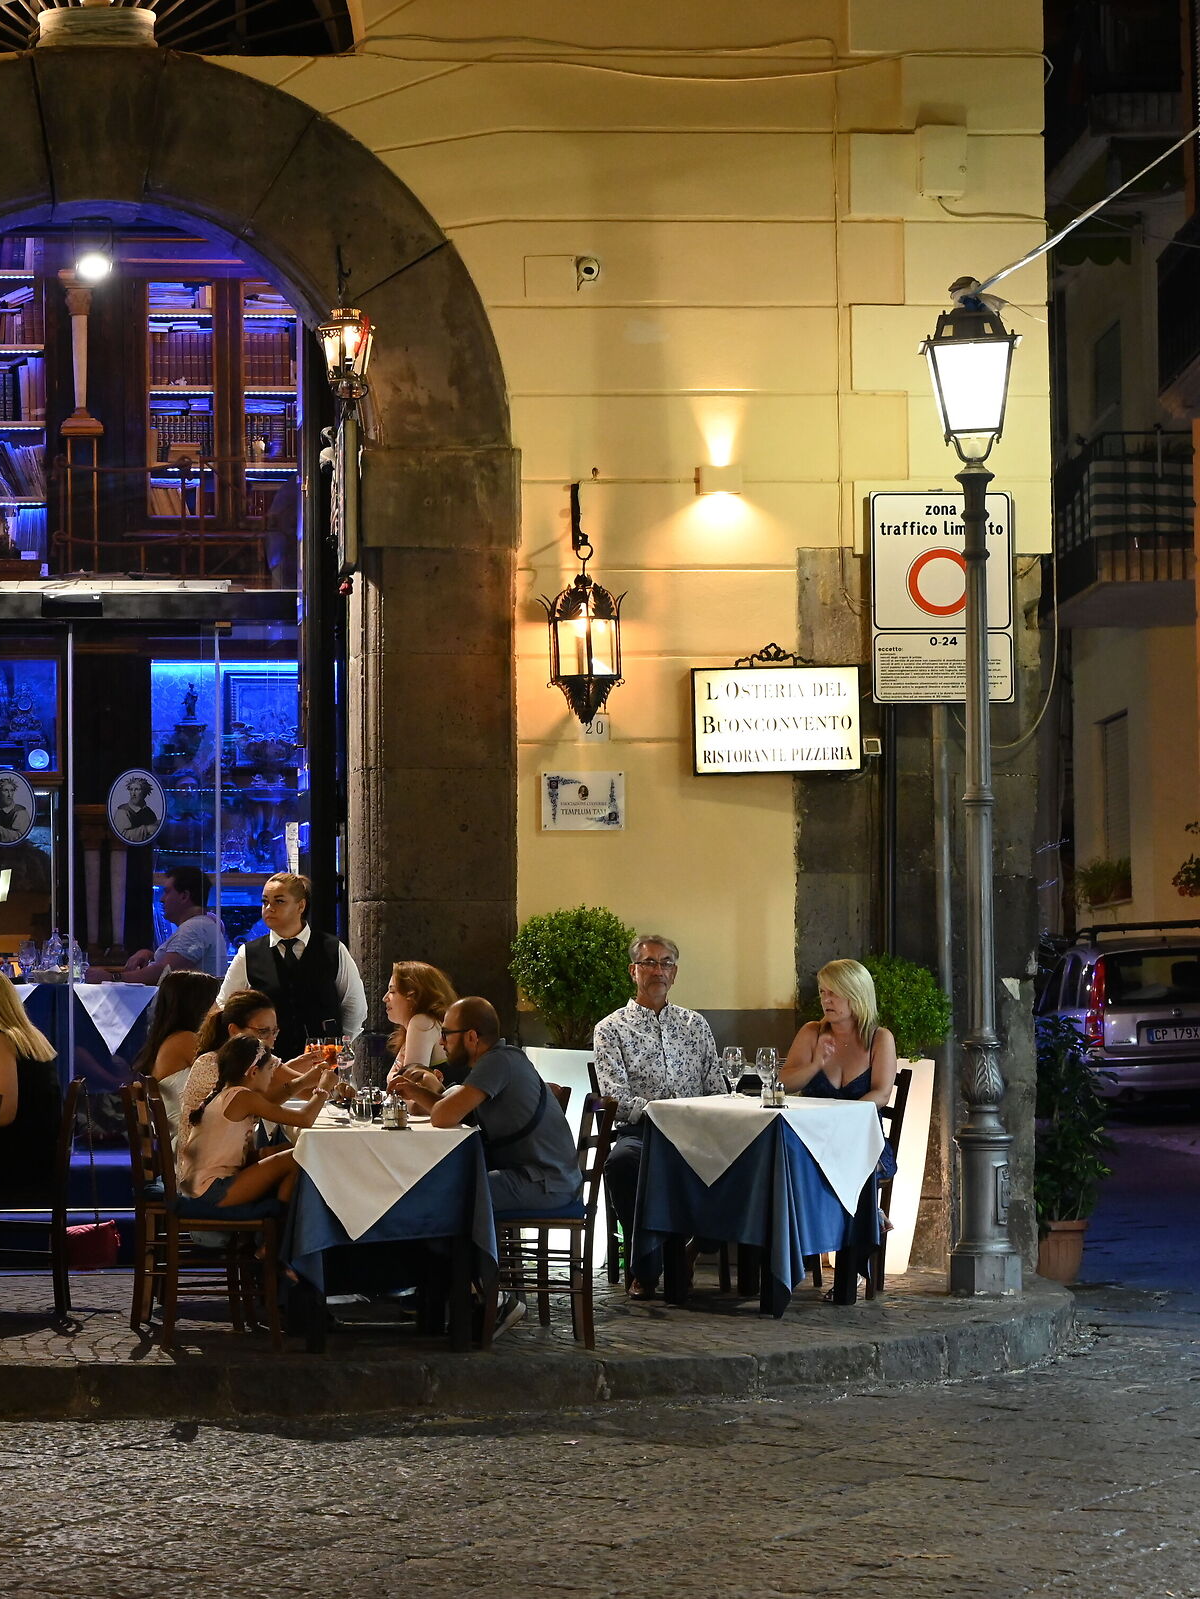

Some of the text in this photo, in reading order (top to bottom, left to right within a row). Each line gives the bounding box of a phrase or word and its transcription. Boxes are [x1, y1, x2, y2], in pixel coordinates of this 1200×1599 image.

[925, 505, 957, 516] zona
[880, 520, 1004, 536] traffico limto
[930, 636, 958, 646] 0-24
[813, 681, 847, 698] DEL
[585, 720, 604, 735] 20
[702, 714, 853, 734] BUONCONVENTO
[703, 746, 853, 764] RISTORANTE PIZZERIA
[1155, 1029, 1168, 1041] CP
